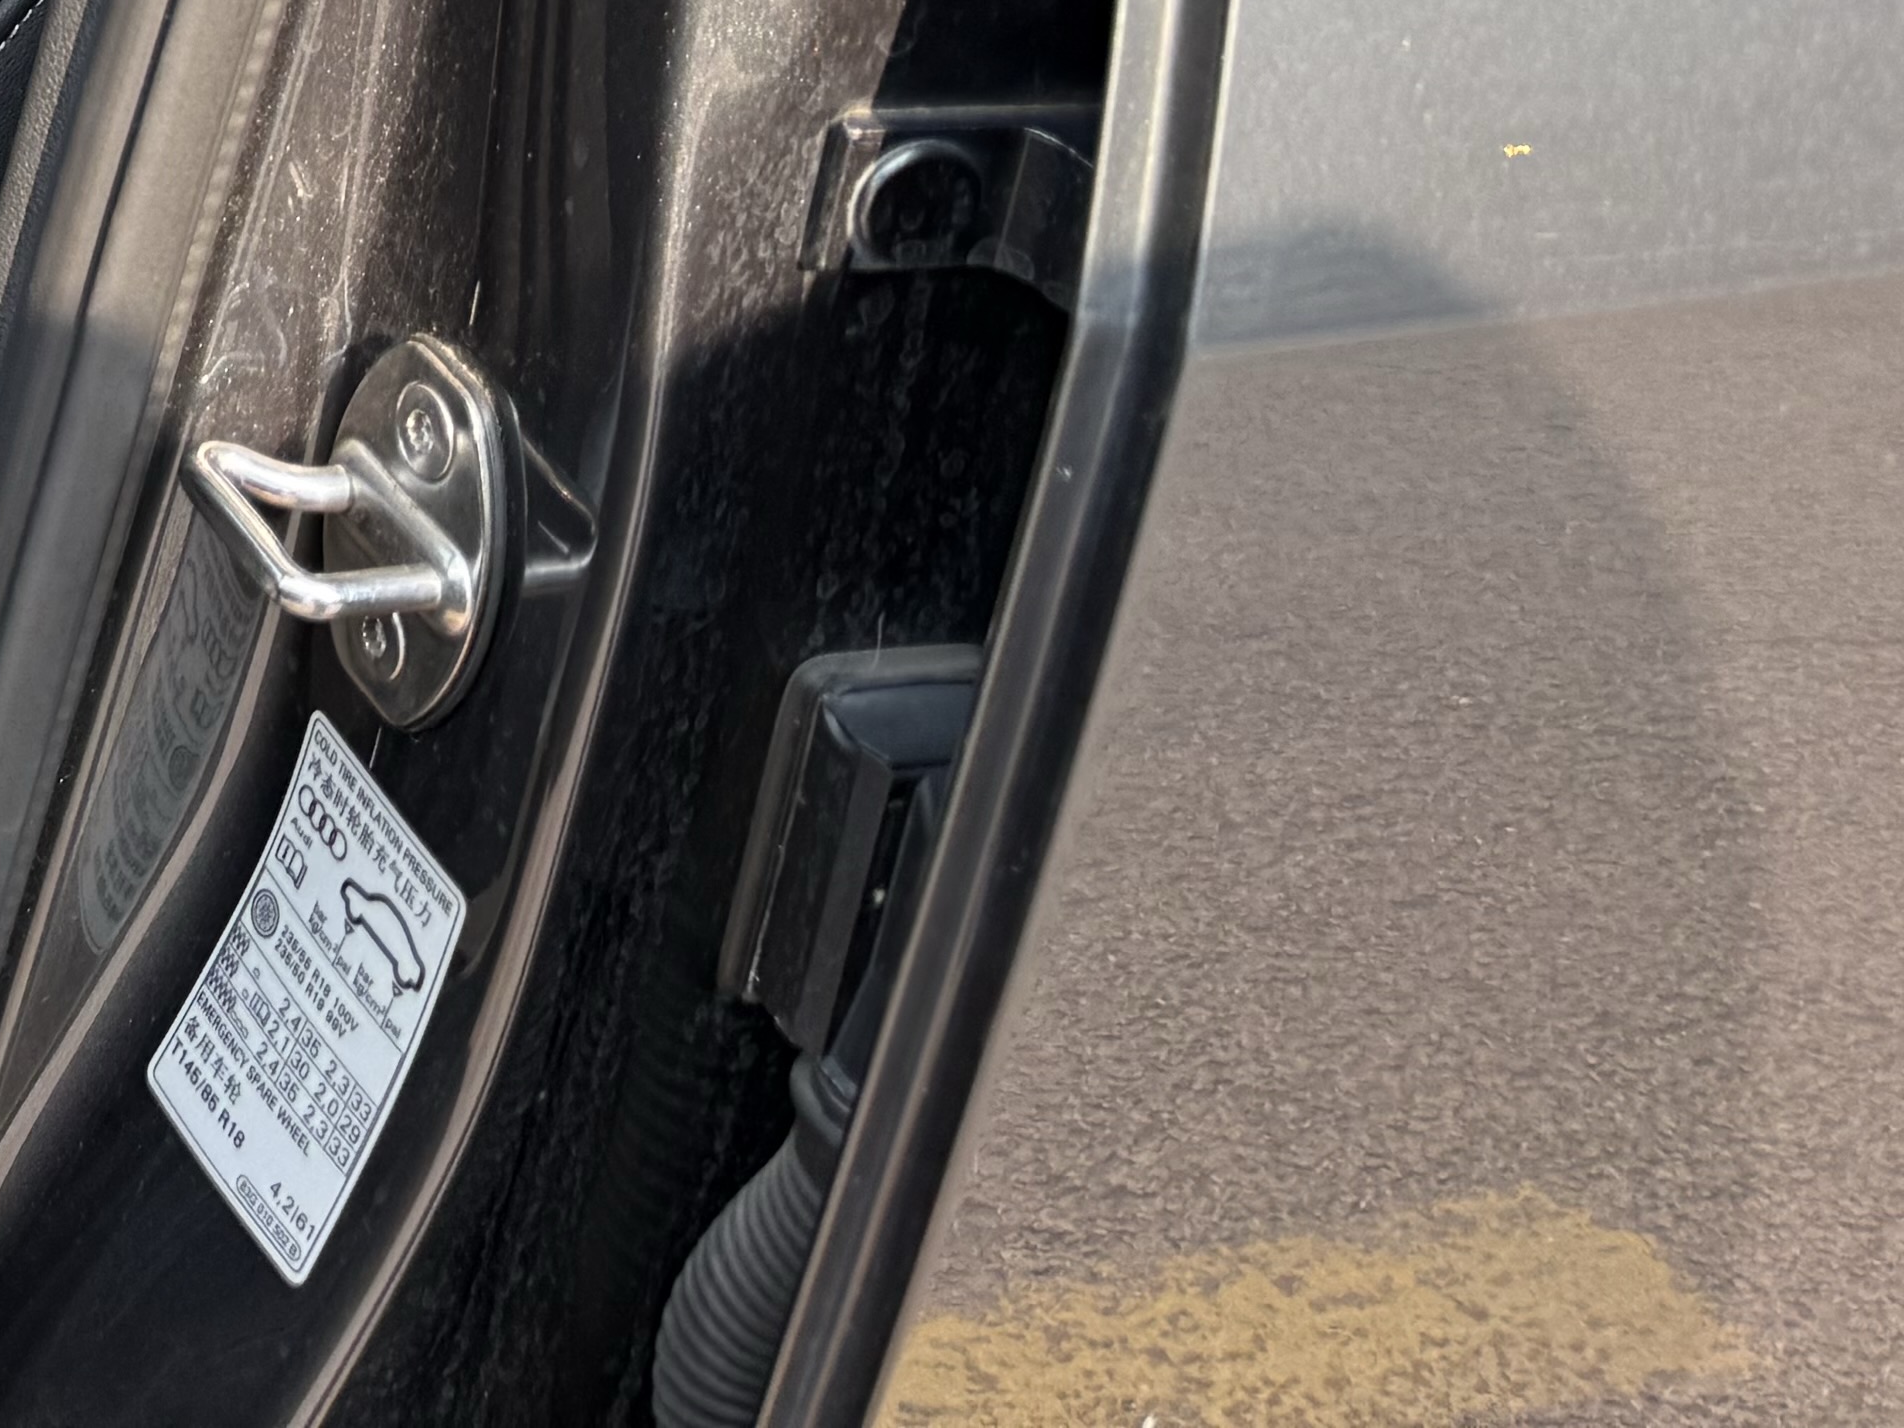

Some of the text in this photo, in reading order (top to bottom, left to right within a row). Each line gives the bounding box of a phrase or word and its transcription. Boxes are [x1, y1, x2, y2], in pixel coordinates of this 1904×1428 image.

[289, 813, 313, 850] Audi
[305, 751, 434, 930] 冷态时轮胎充气压力
[313, 728, 453, 917] COLD TIRE INFLATION PRESSURE
[169, 1035, 246, 1152] T145/85 R18
[182, 1010, 244, 1107] 备用车轮
[195, 989, 313, 1157] EMERGENCY SPARE WHEEL
[254, 1037, 350, 1169] 2,4 35 2,3 33
[265, 1017, 362, 1147] 2,1 30 2,0 29
[277, 994, 373, 1124] 2,4 35 2,3 33
